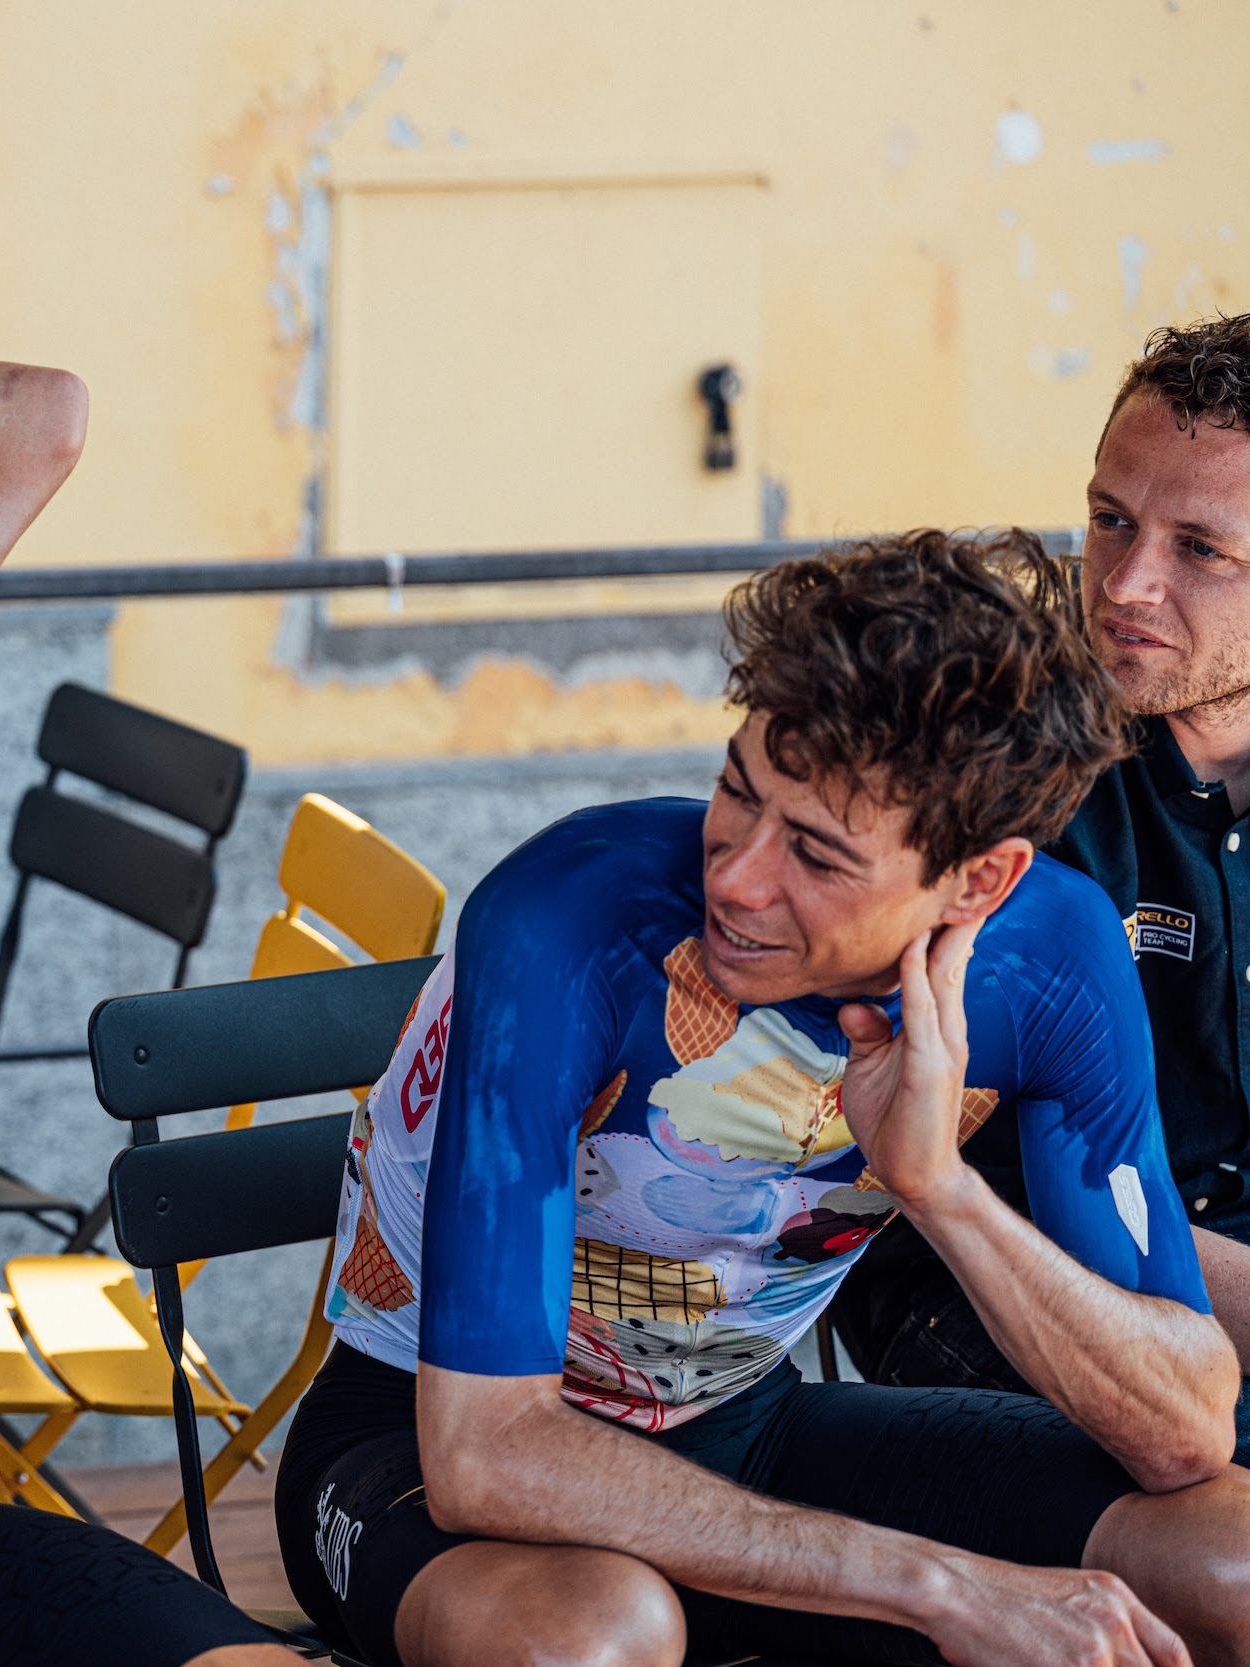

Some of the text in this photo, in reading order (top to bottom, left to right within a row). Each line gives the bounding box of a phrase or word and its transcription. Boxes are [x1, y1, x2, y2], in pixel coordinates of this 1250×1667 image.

[1143, 931, 1188, 947] PRO CYCLING
[1143, 938, 1164, 946] TEAM
